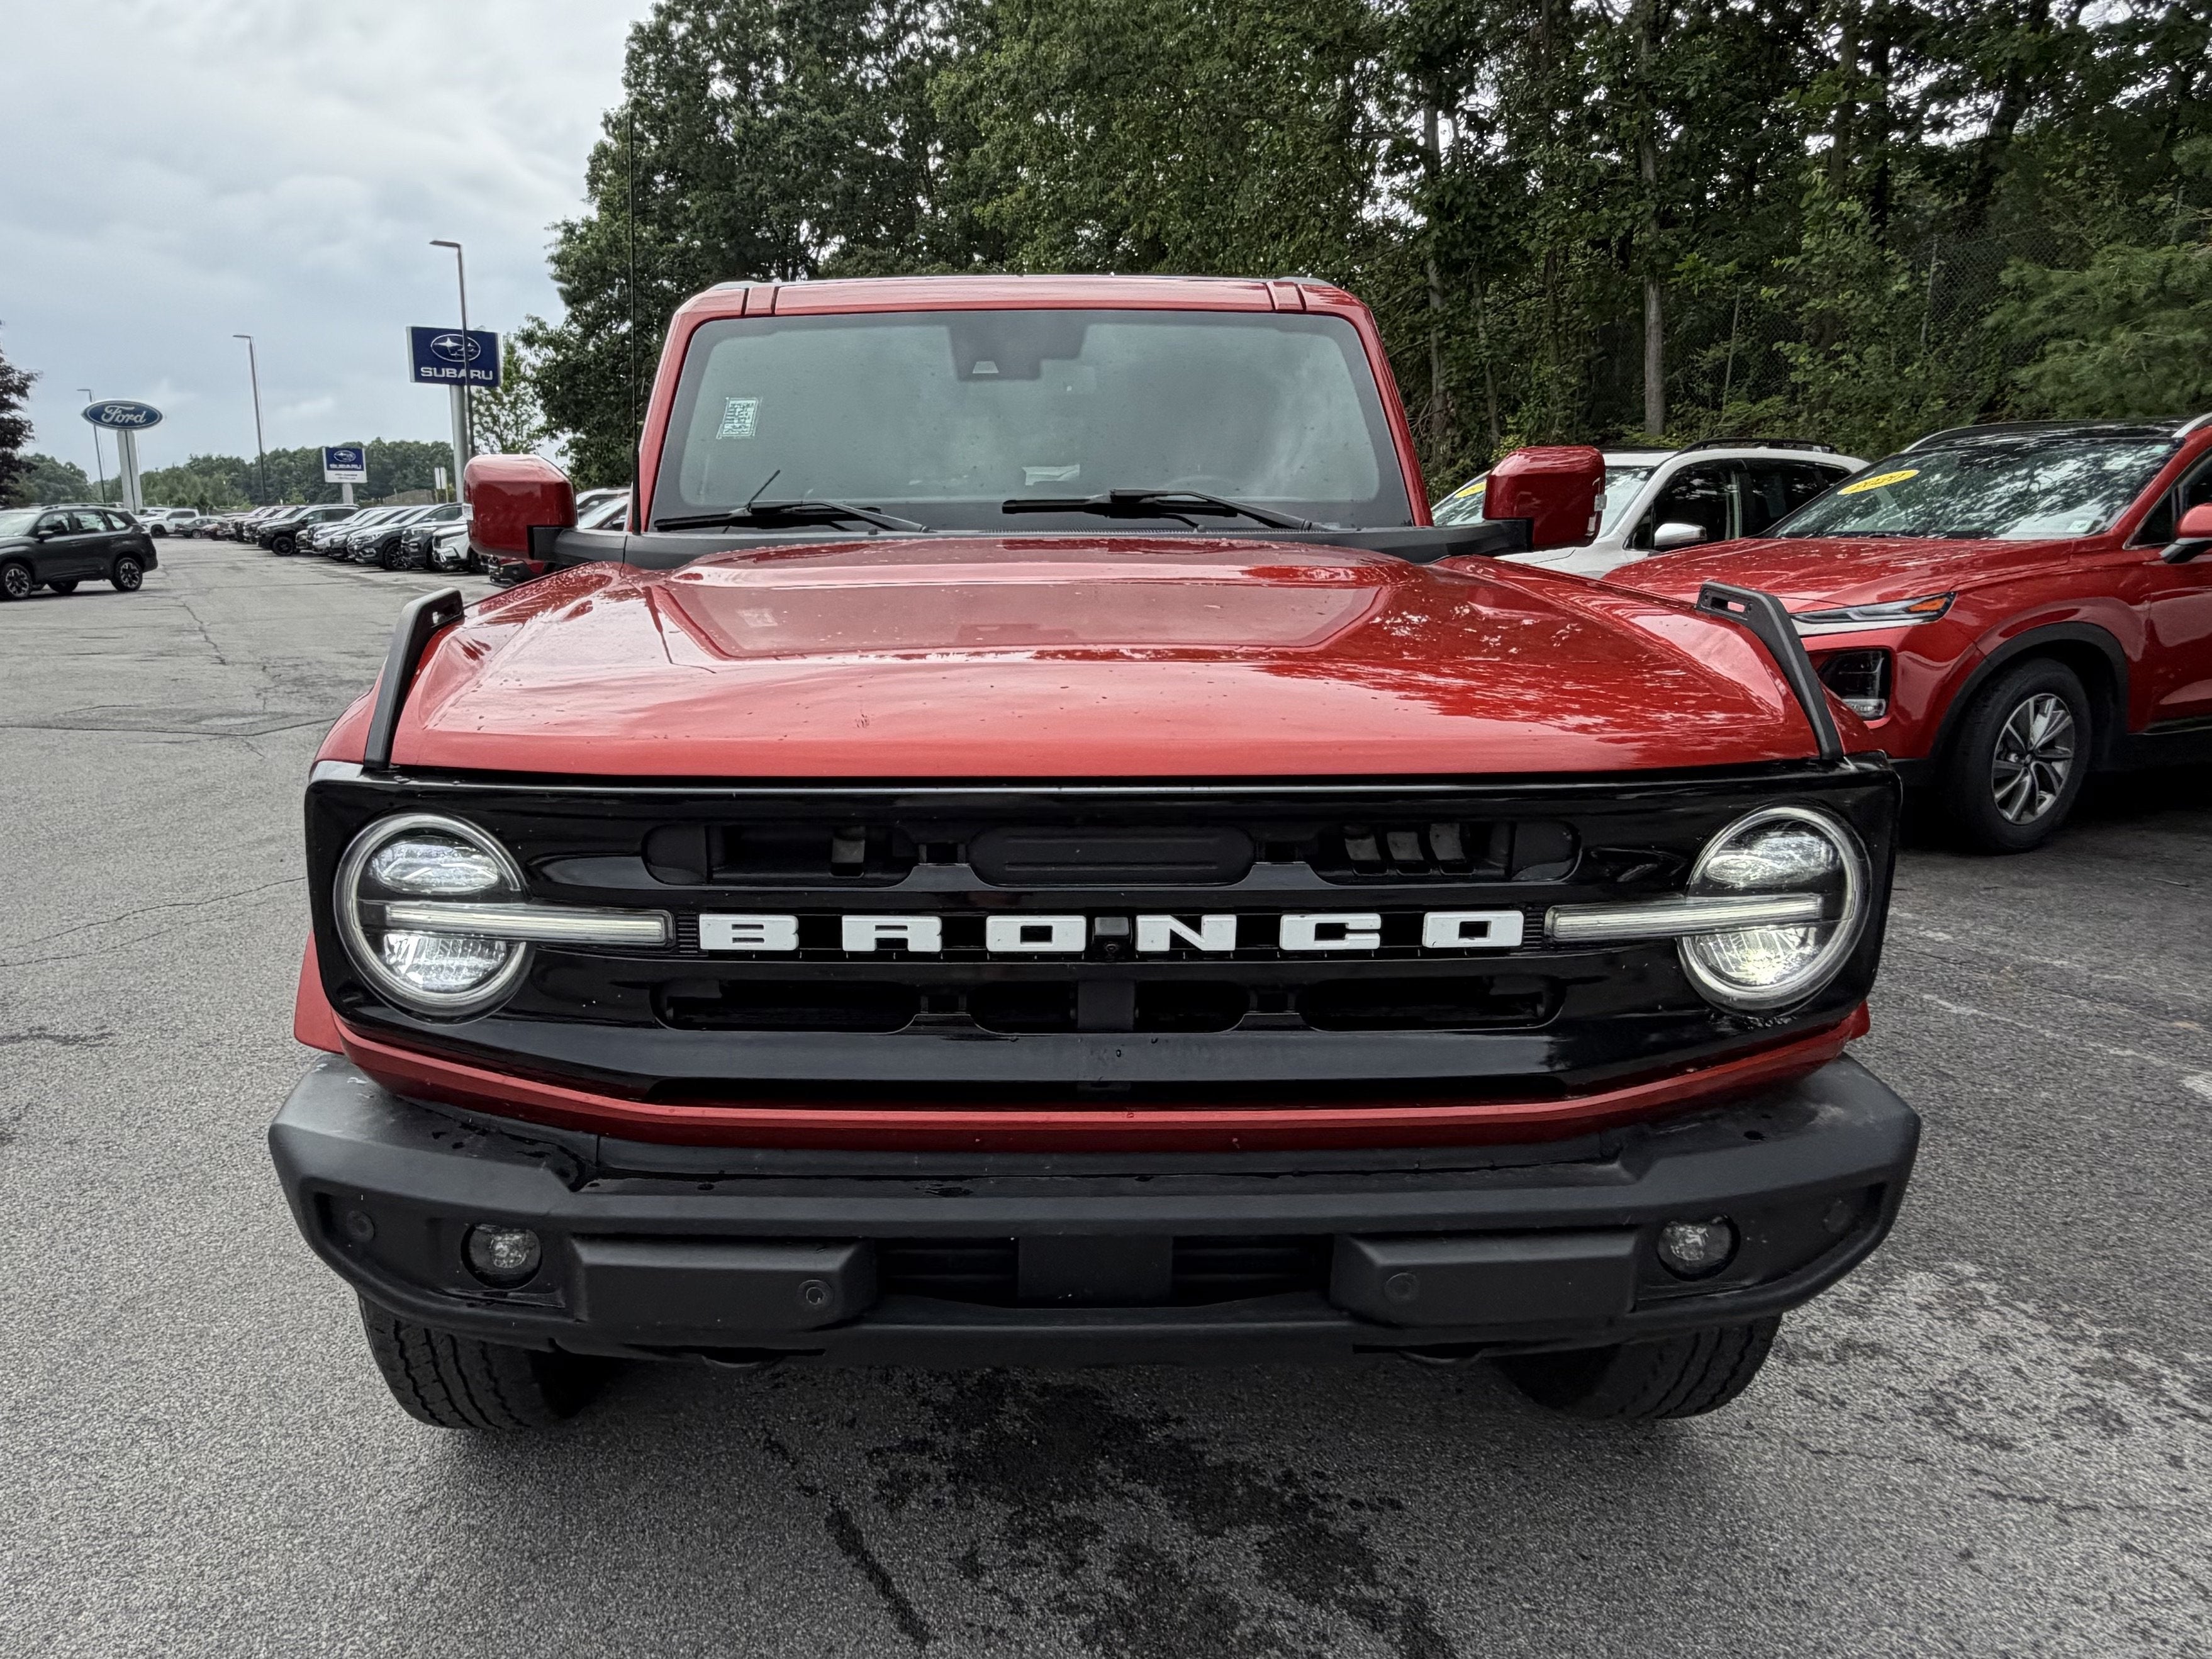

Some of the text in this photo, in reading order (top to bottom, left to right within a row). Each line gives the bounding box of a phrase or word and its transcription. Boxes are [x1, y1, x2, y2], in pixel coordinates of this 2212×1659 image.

[420, 367, 493, 381] SUBARU
[101, 405, 147, 423] Ford
[698, 910, 1525, 951] BRONCO
